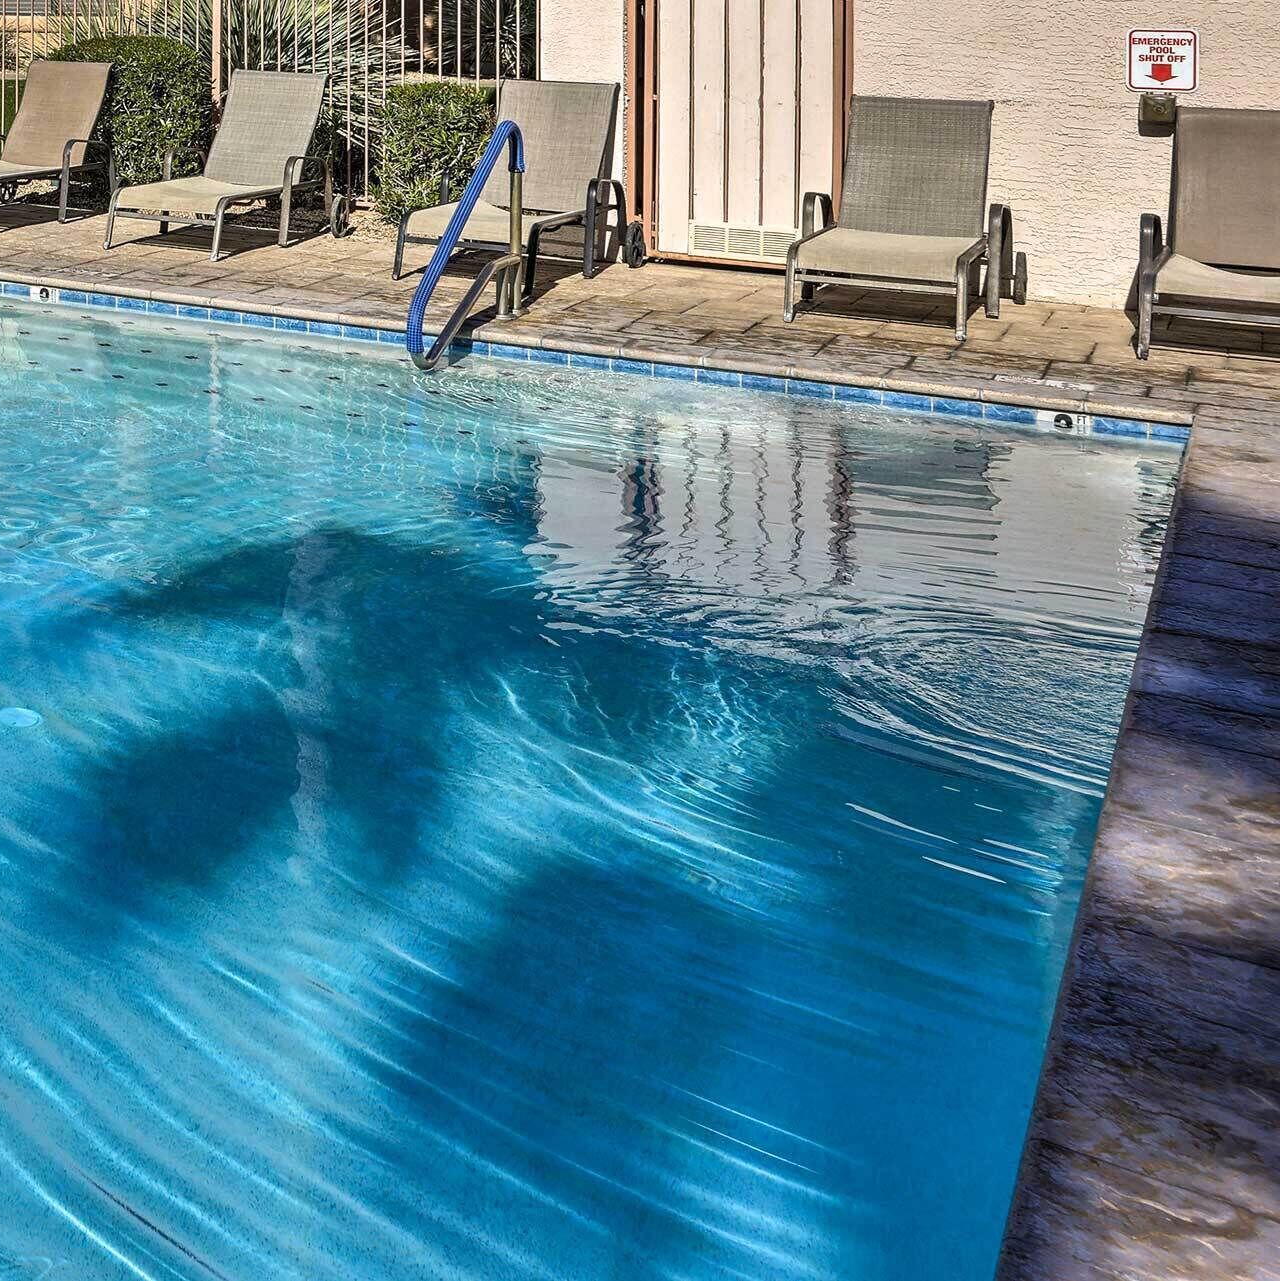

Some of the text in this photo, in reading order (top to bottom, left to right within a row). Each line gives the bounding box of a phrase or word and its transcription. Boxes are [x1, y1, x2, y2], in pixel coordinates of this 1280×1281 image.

[1132, 38, 1193, 46] EMERGENCY
[1149, 46, 1175, 54] POOL
[1138, 54, 1186, 63] SHUT OFF
